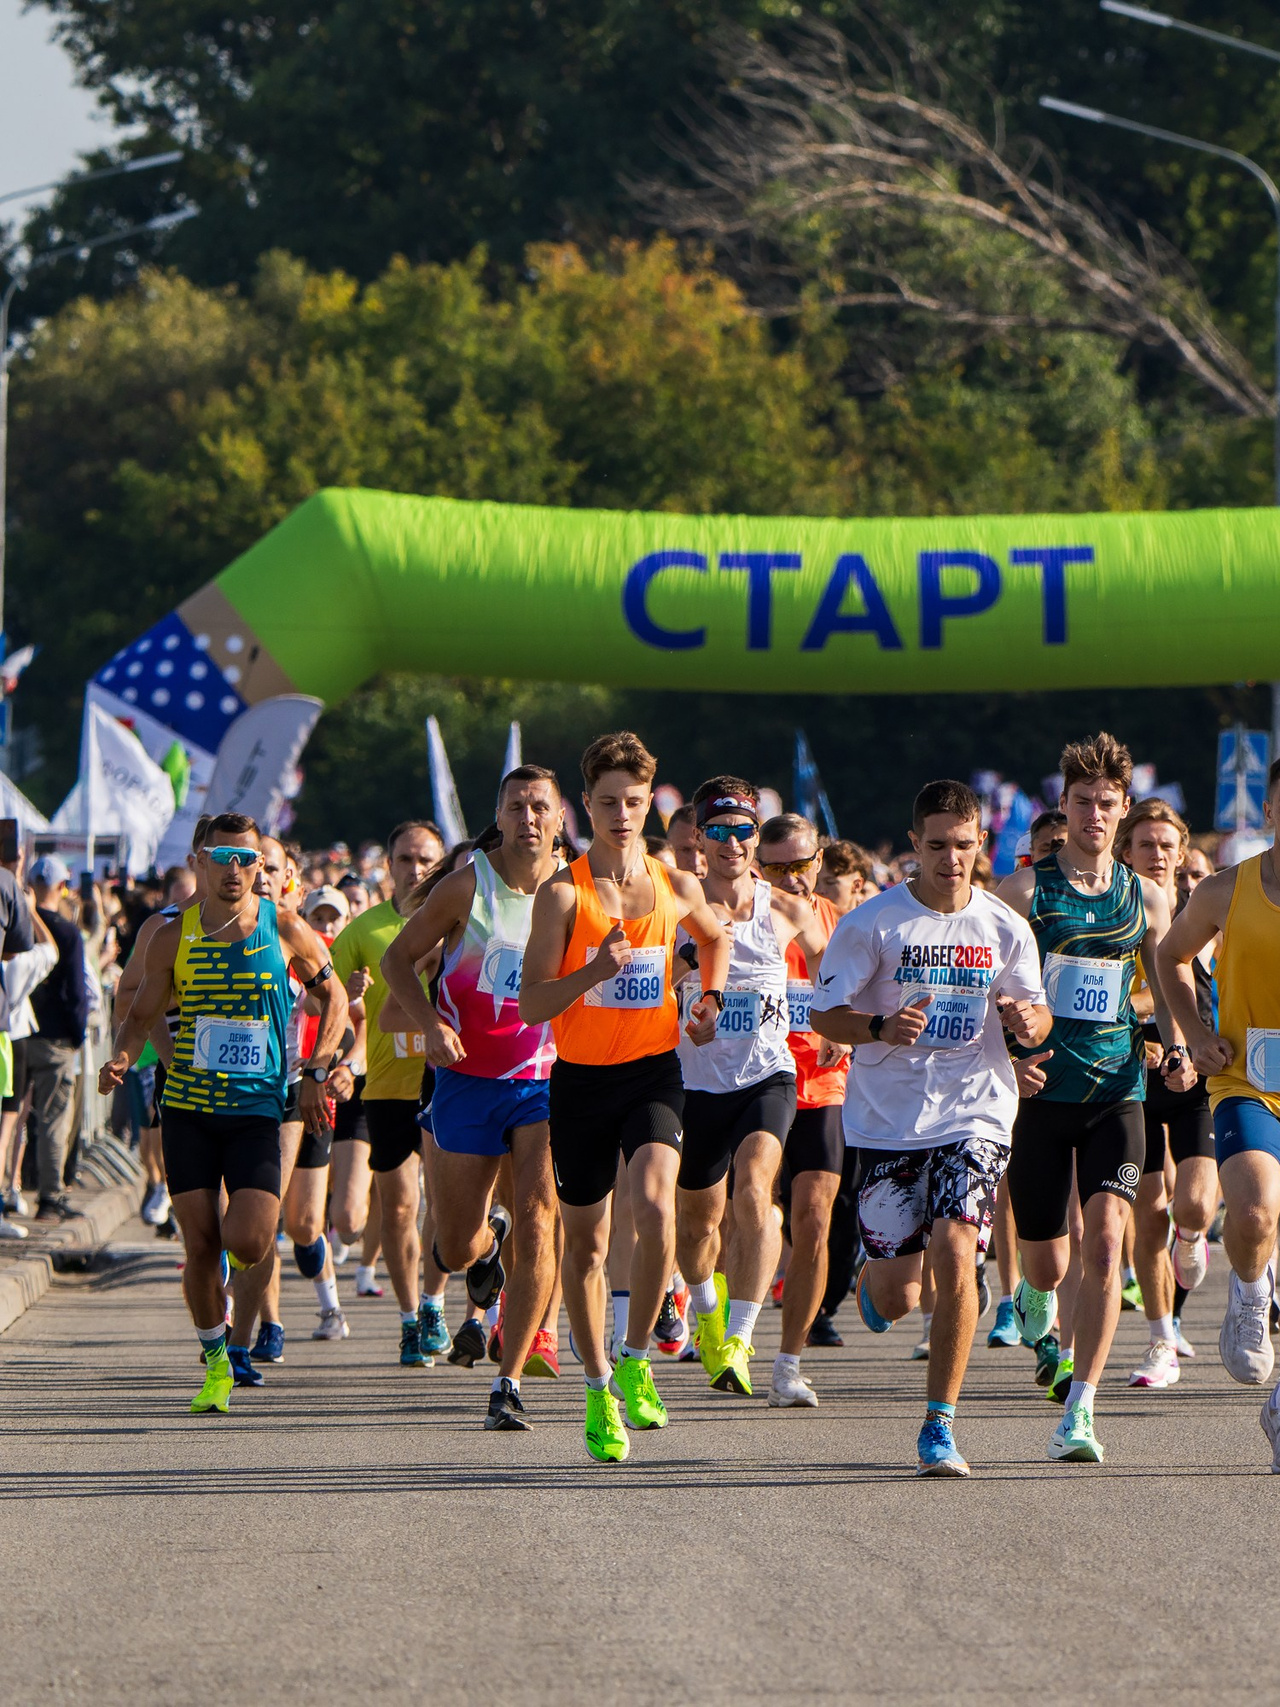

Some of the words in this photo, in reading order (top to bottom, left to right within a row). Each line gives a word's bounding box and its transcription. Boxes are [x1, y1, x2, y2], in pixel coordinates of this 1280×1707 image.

[621, 545, 1094, 652] СТАРТ
[900, 944, 993, 969] #ЗАБЕГ2025
[622, 963, 655, 975] ДАНИИЛ
[893, 967, 925, 985] 45%
[1082, 974, 1104, 986] ИЛЬЯ
[614, 976, 660, 1001] 3689
[935, 1000, 969, 1014] РОДИОН
[1073, 987, 1109, 1014] 308
[228, 1032, 254, 1043] ДЕНИС
[924, 1014, 976, 1042] 4065
[218, 1043, 260, 1066] 2335
